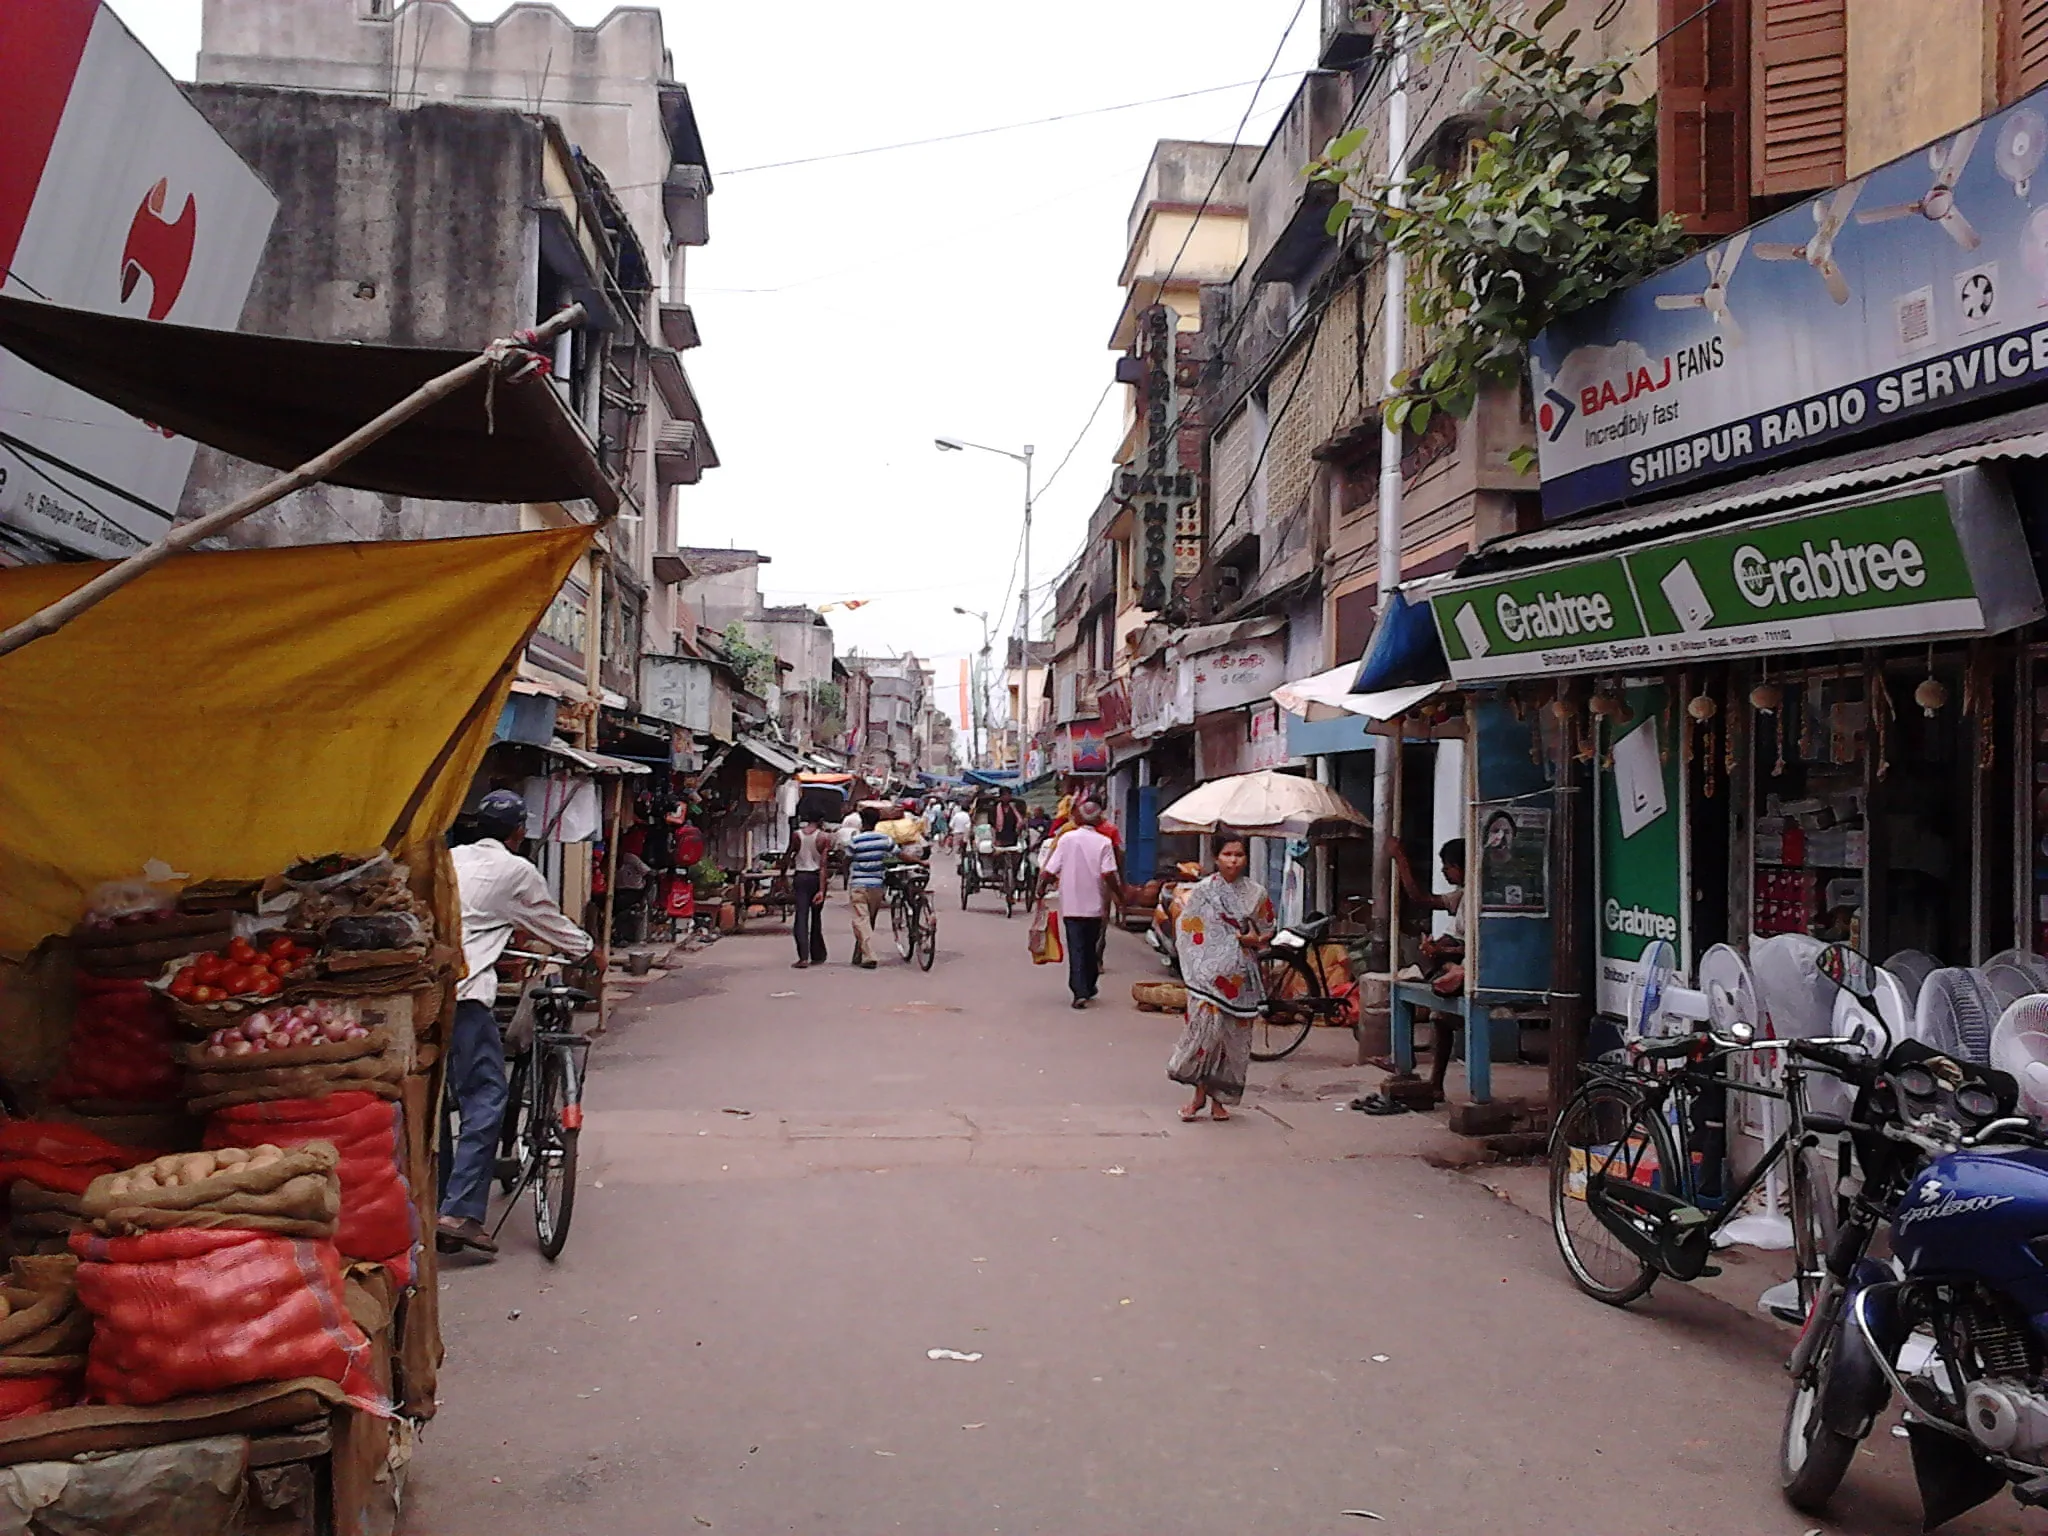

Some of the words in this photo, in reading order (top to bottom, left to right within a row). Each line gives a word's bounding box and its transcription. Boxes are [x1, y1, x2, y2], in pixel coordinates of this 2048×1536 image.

[1580, 357, 1671, 416] BAJAJ
[1677, 336, 1725, 381] FANS
[1585, 408, 1650, 447] Incredibly
[1653, 399, 1681, 426] fast
[1629, 423, 1753, 487] SHIBPUR
[1761, 387, 1867, 449] RADIO
[1876, 326, 2048, 414] SERVICE
[36, 494, 74, 526] Shibpur
[1733, 537, 1927, 608] Crabtree
[1496, 590, 1614, 643] Crabtree
[1541, 652, 1577, 668] Shibpur
[1579, 647, 1608, 663] Radio
[1609, 643, 1651, 660] Service
[1605, 898, 1677, 941] Crabtree
